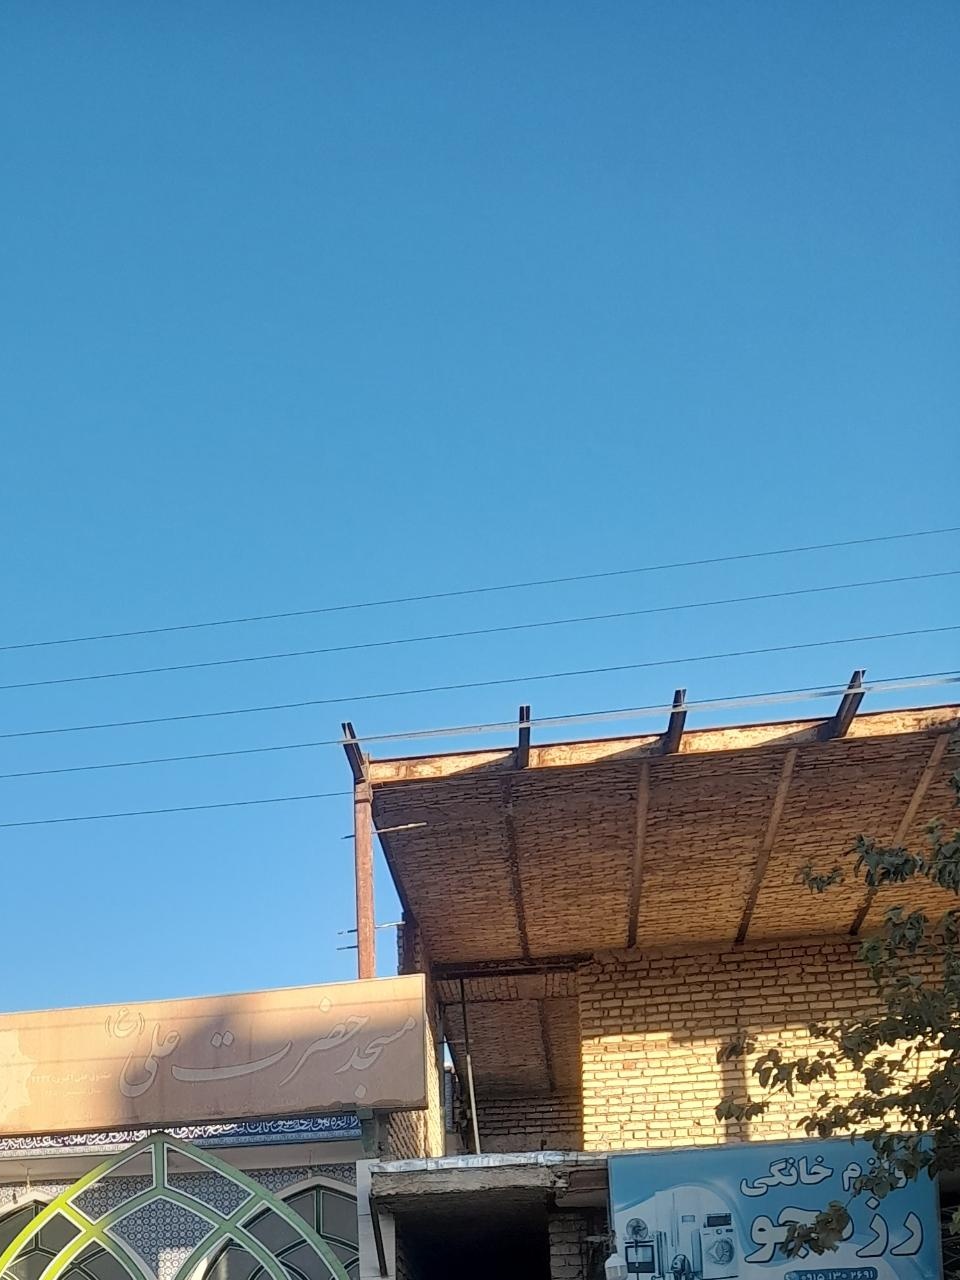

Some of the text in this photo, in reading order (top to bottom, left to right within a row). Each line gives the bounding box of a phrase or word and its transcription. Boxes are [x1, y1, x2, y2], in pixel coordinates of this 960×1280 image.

[104, 996, 417, 1099] مسجد حضرت علی (ع)
[739, 1149, 914, 1198] وزم خانگی
